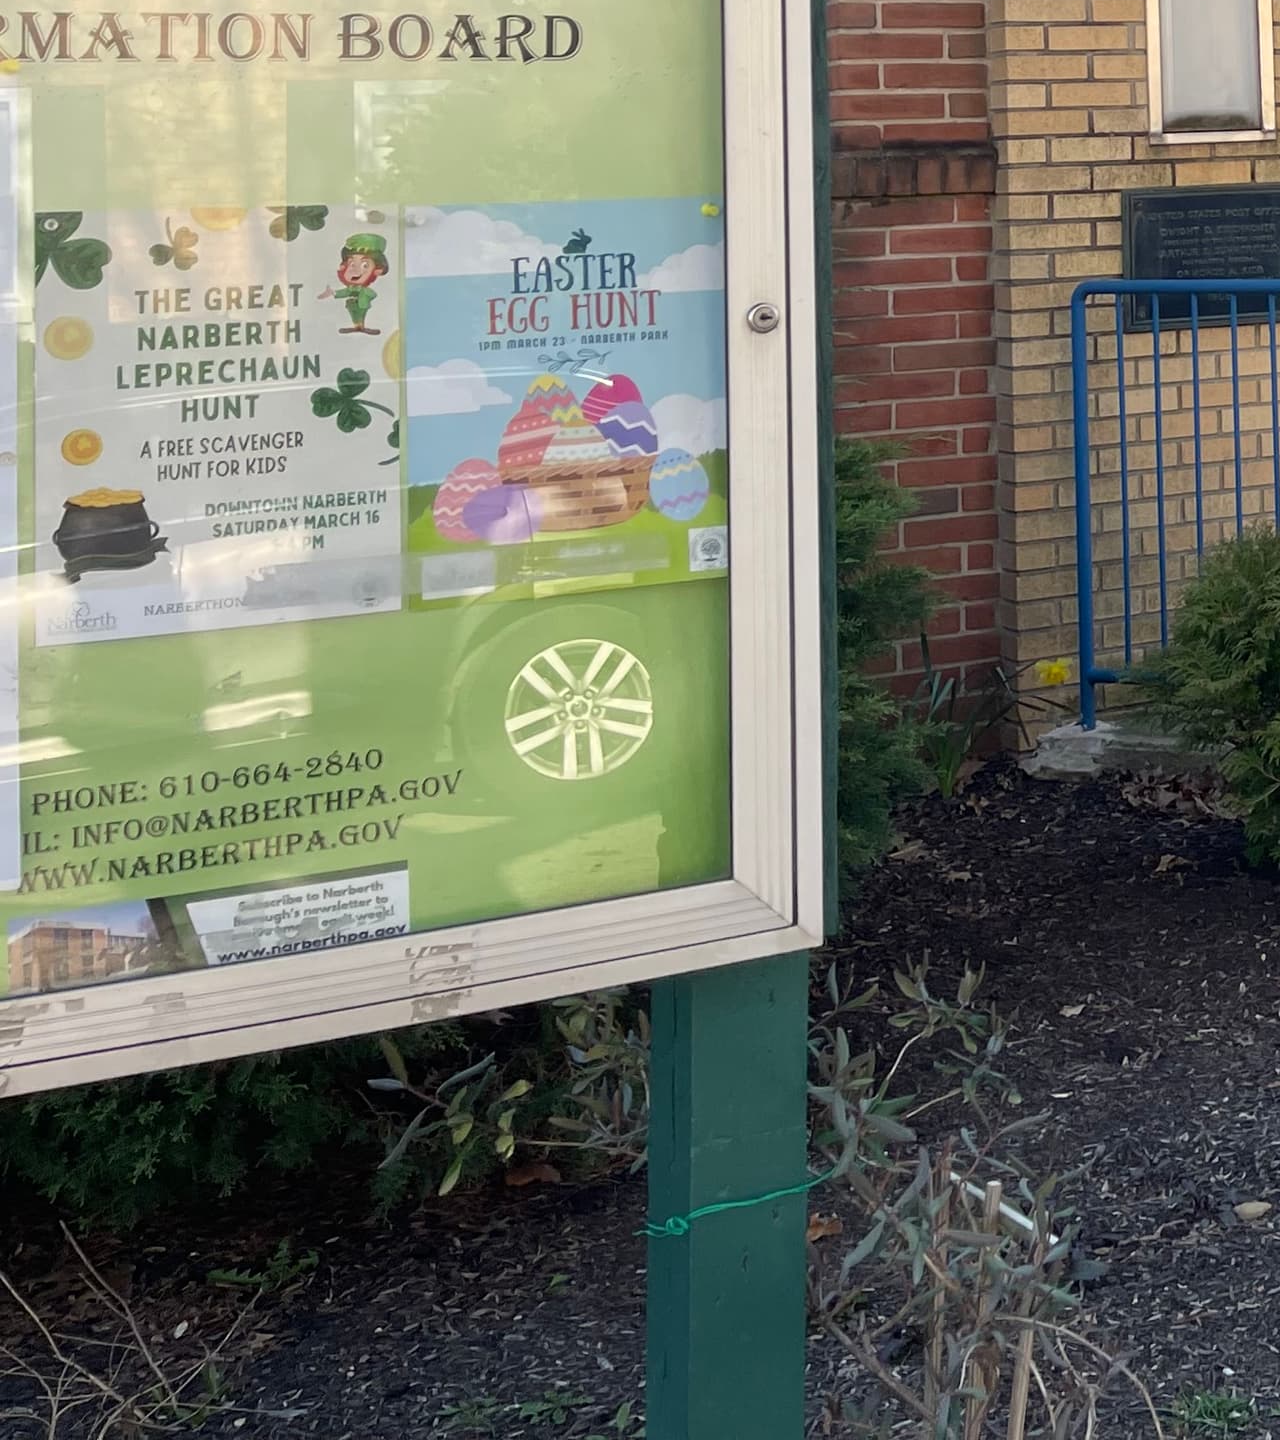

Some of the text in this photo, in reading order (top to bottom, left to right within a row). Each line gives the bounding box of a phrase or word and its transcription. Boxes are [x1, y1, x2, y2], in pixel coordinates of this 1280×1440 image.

[337, 13, 583, 65] BOARD
[510, 252, 637, 294] EASTER
[135, 284, 304, 315] THE GREAT
[486, 289, 662, 336] EGG HUNT
[137, 319, 302, 351] NARBERTH
[479, 340, 501, 351] 1PM
[506, 337, 547, 350] MARCH
[552, 336, 566, 347] 23
[580, 332, 636, 345] NARBERTH
[640, 330, 669, 341] PARK
[116, 354, 321, 390] LEPRECHAUN
[181, 394, 260, 424] HUNT
[140, 431, 304, 459] A FREE SCAVENGER
[156, 456, 287, 483] HUNT FOR KIDS
[205, 489, 388, 517] DOWNTOWN NARBERTH
[213, 510, 380, 538] SATURDAY MARCH 16
[32, 748, 384, 816] PHONE: 610-664-2840
[72, 768, 465, 849] INFO@NARBERTHPA.GOV
[304, 897, 372, 917] newsletter
[375, 895, 389, 906] to
[306, 891, 320, 902] to
[323, 880, 384, 900] Narberth
[216, 922, 408, 963] www.narberthpa.gov
